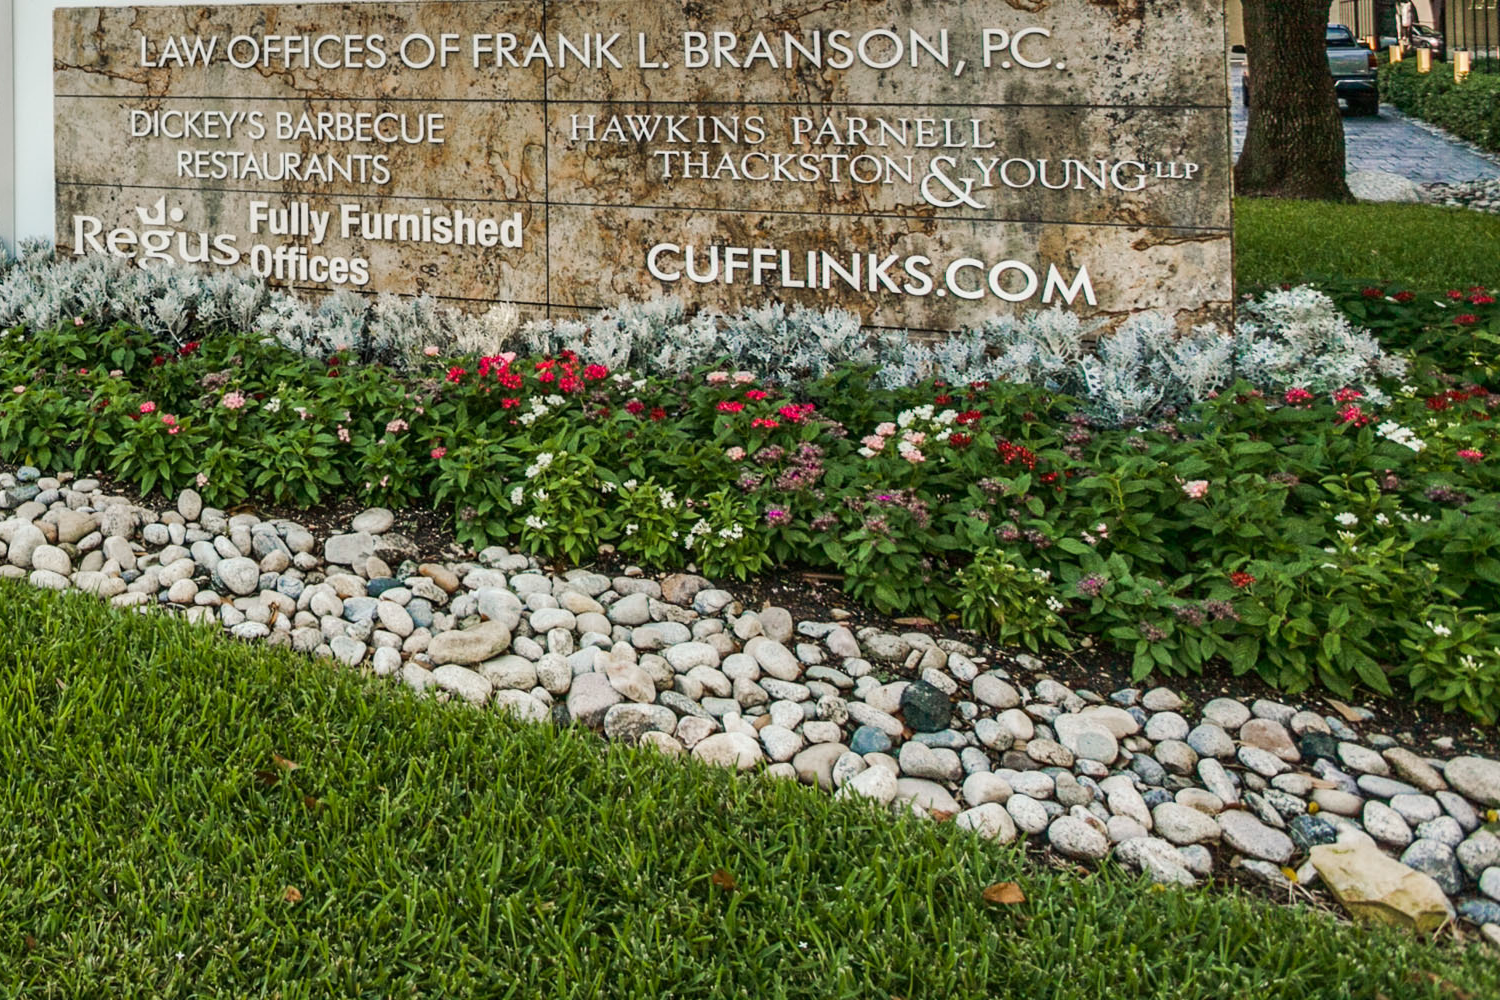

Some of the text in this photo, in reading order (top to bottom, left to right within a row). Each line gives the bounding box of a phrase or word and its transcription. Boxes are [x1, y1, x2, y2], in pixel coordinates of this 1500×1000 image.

[140, 26, 1066, 76] LAW OFFICES OF FRANK L. BRANSON, P.C.
[131, 110, 445, 144] DICKEY'S BARBECUE
[569, 114, 997, 150] HAWKINS PARNELL
[177, 150, 391, 186] RESTAURANTS
[654, 150, 1199, 209] THACKSTON & YOUNG LLP
[73, 214, 241, 271] Regus
[250, 200, 523, 249] Fully Furnished
[250, 243, 370, 286] Offices
[646, 242, 1098, 307] CUFFLINKS.COM
